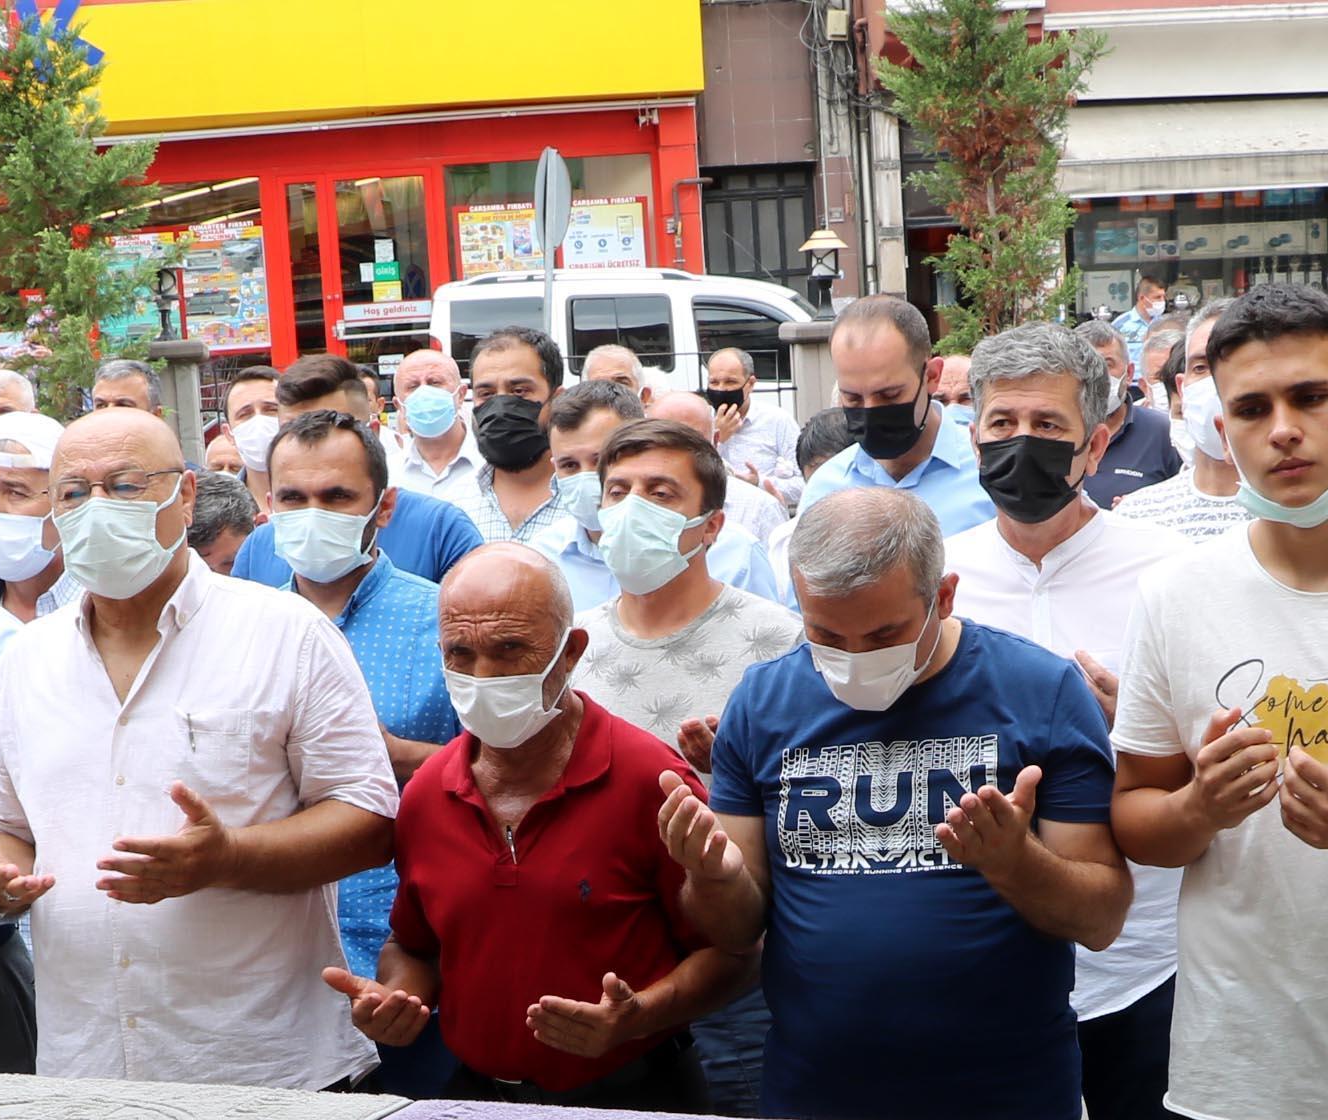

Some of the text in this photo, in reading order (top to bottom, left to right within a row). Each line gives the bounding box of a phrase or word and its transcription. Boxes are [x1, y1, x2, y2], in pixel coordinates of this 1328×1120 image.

[384, 305, 417, 316] geldiniz
[784, 764, 987, 832] RUN
[810, 863, 964, 876] LEGENDARY RUNNING EXPERIENCE
